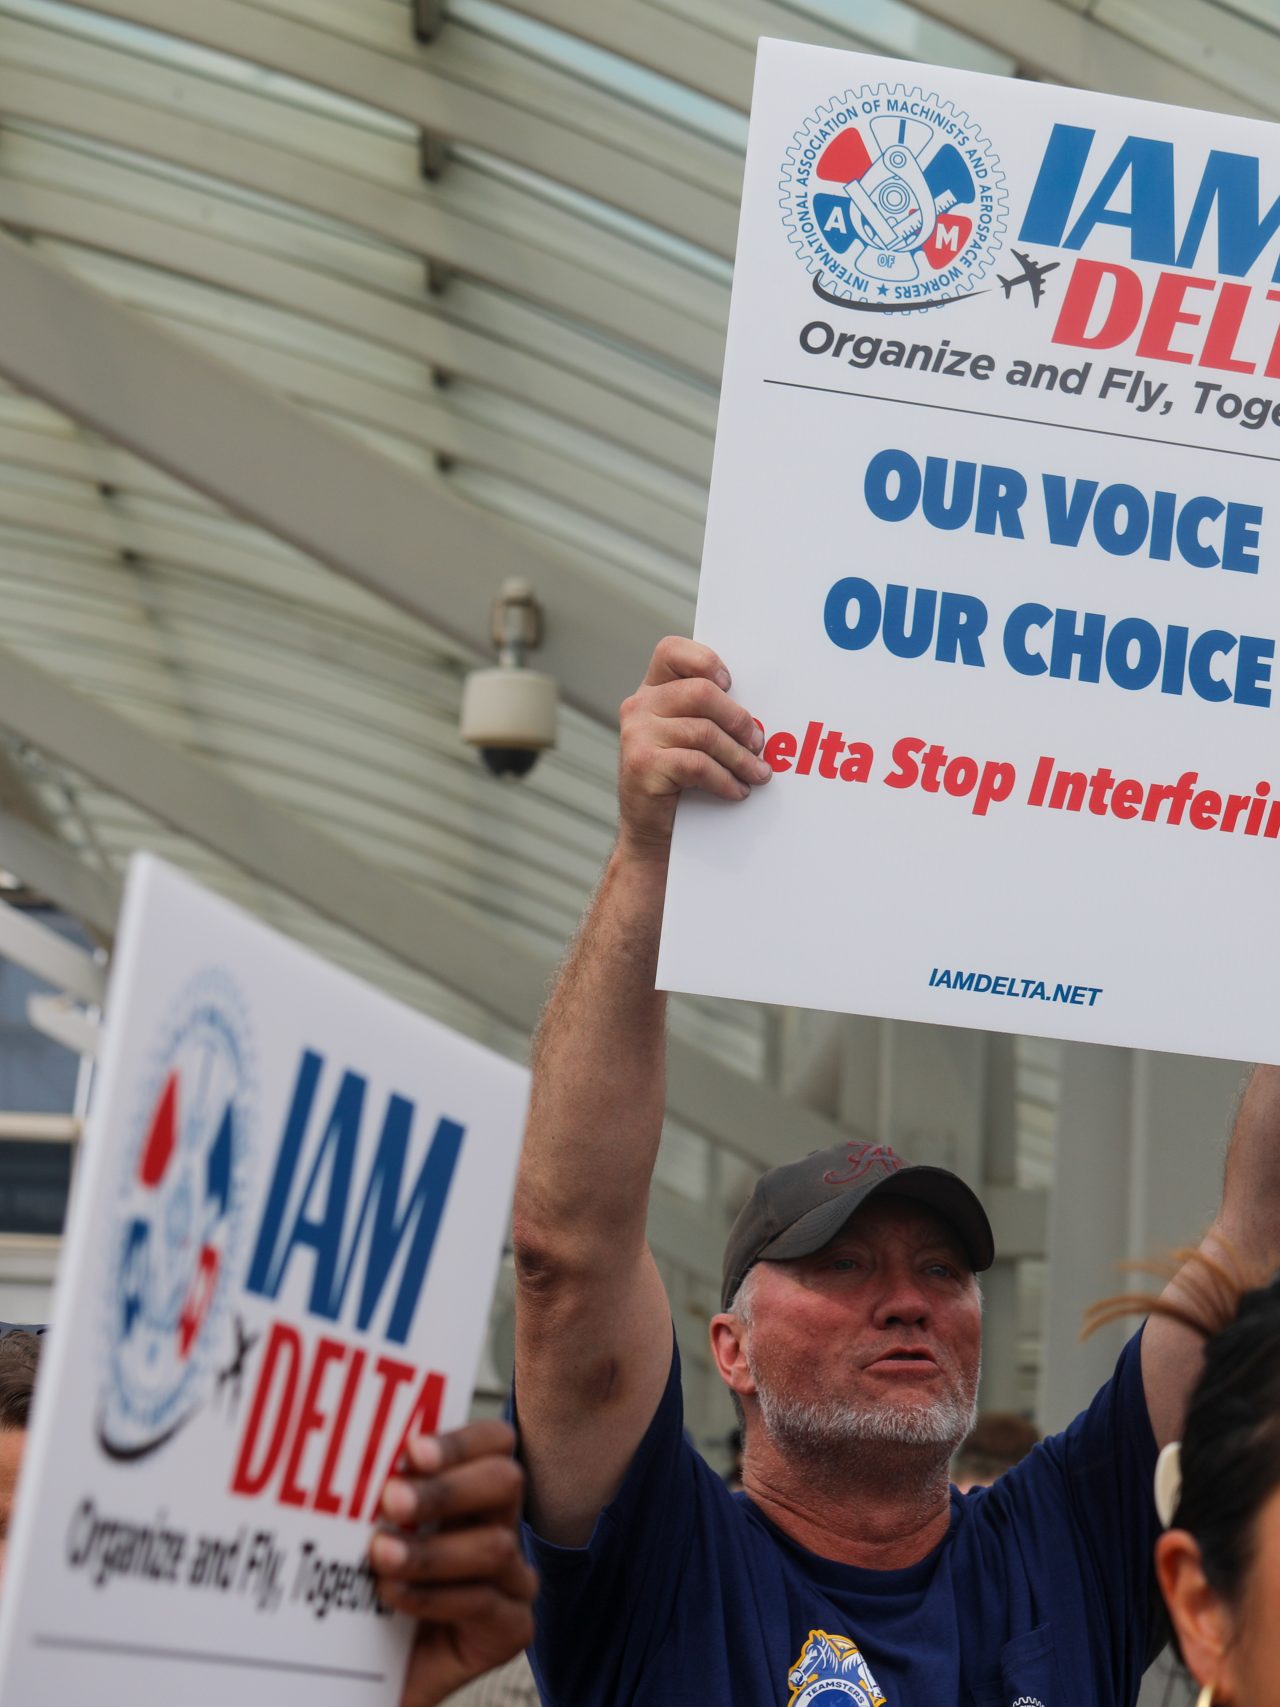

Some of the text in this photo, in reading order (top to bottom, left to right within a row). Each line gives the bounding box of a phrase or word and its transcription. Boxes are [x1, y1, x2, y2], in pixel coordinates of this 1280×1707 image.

[795, 99, 993, 299] INTERNATIONAL ASSOCIATION OF MACHINISTS AND AEROSPACE WORKERS
[823, 206, 848, 235] A
[935, 223, 960, 252] M
[799, 320, 996, 383] Organize
[1005, 360, 1094, 395] and
[1099, 366, 1173, 416] Fly,
[864, 449, 1264, 575] OUR VOICE
[824, 577, 1275, 709] OUR CHOICE
[751, 717, 874, 783] elta
[884, 736, 1015, 817] Stop
[928, 968, 1103, 1007] IAMDELTA.NET
[245, 1049, 467, 1346] IAM
[66, 1495, 187, 1591] Organize
[188, 1525, 247, 1592] and
[806, 1682, 865, 1705] TEAMSTERS
